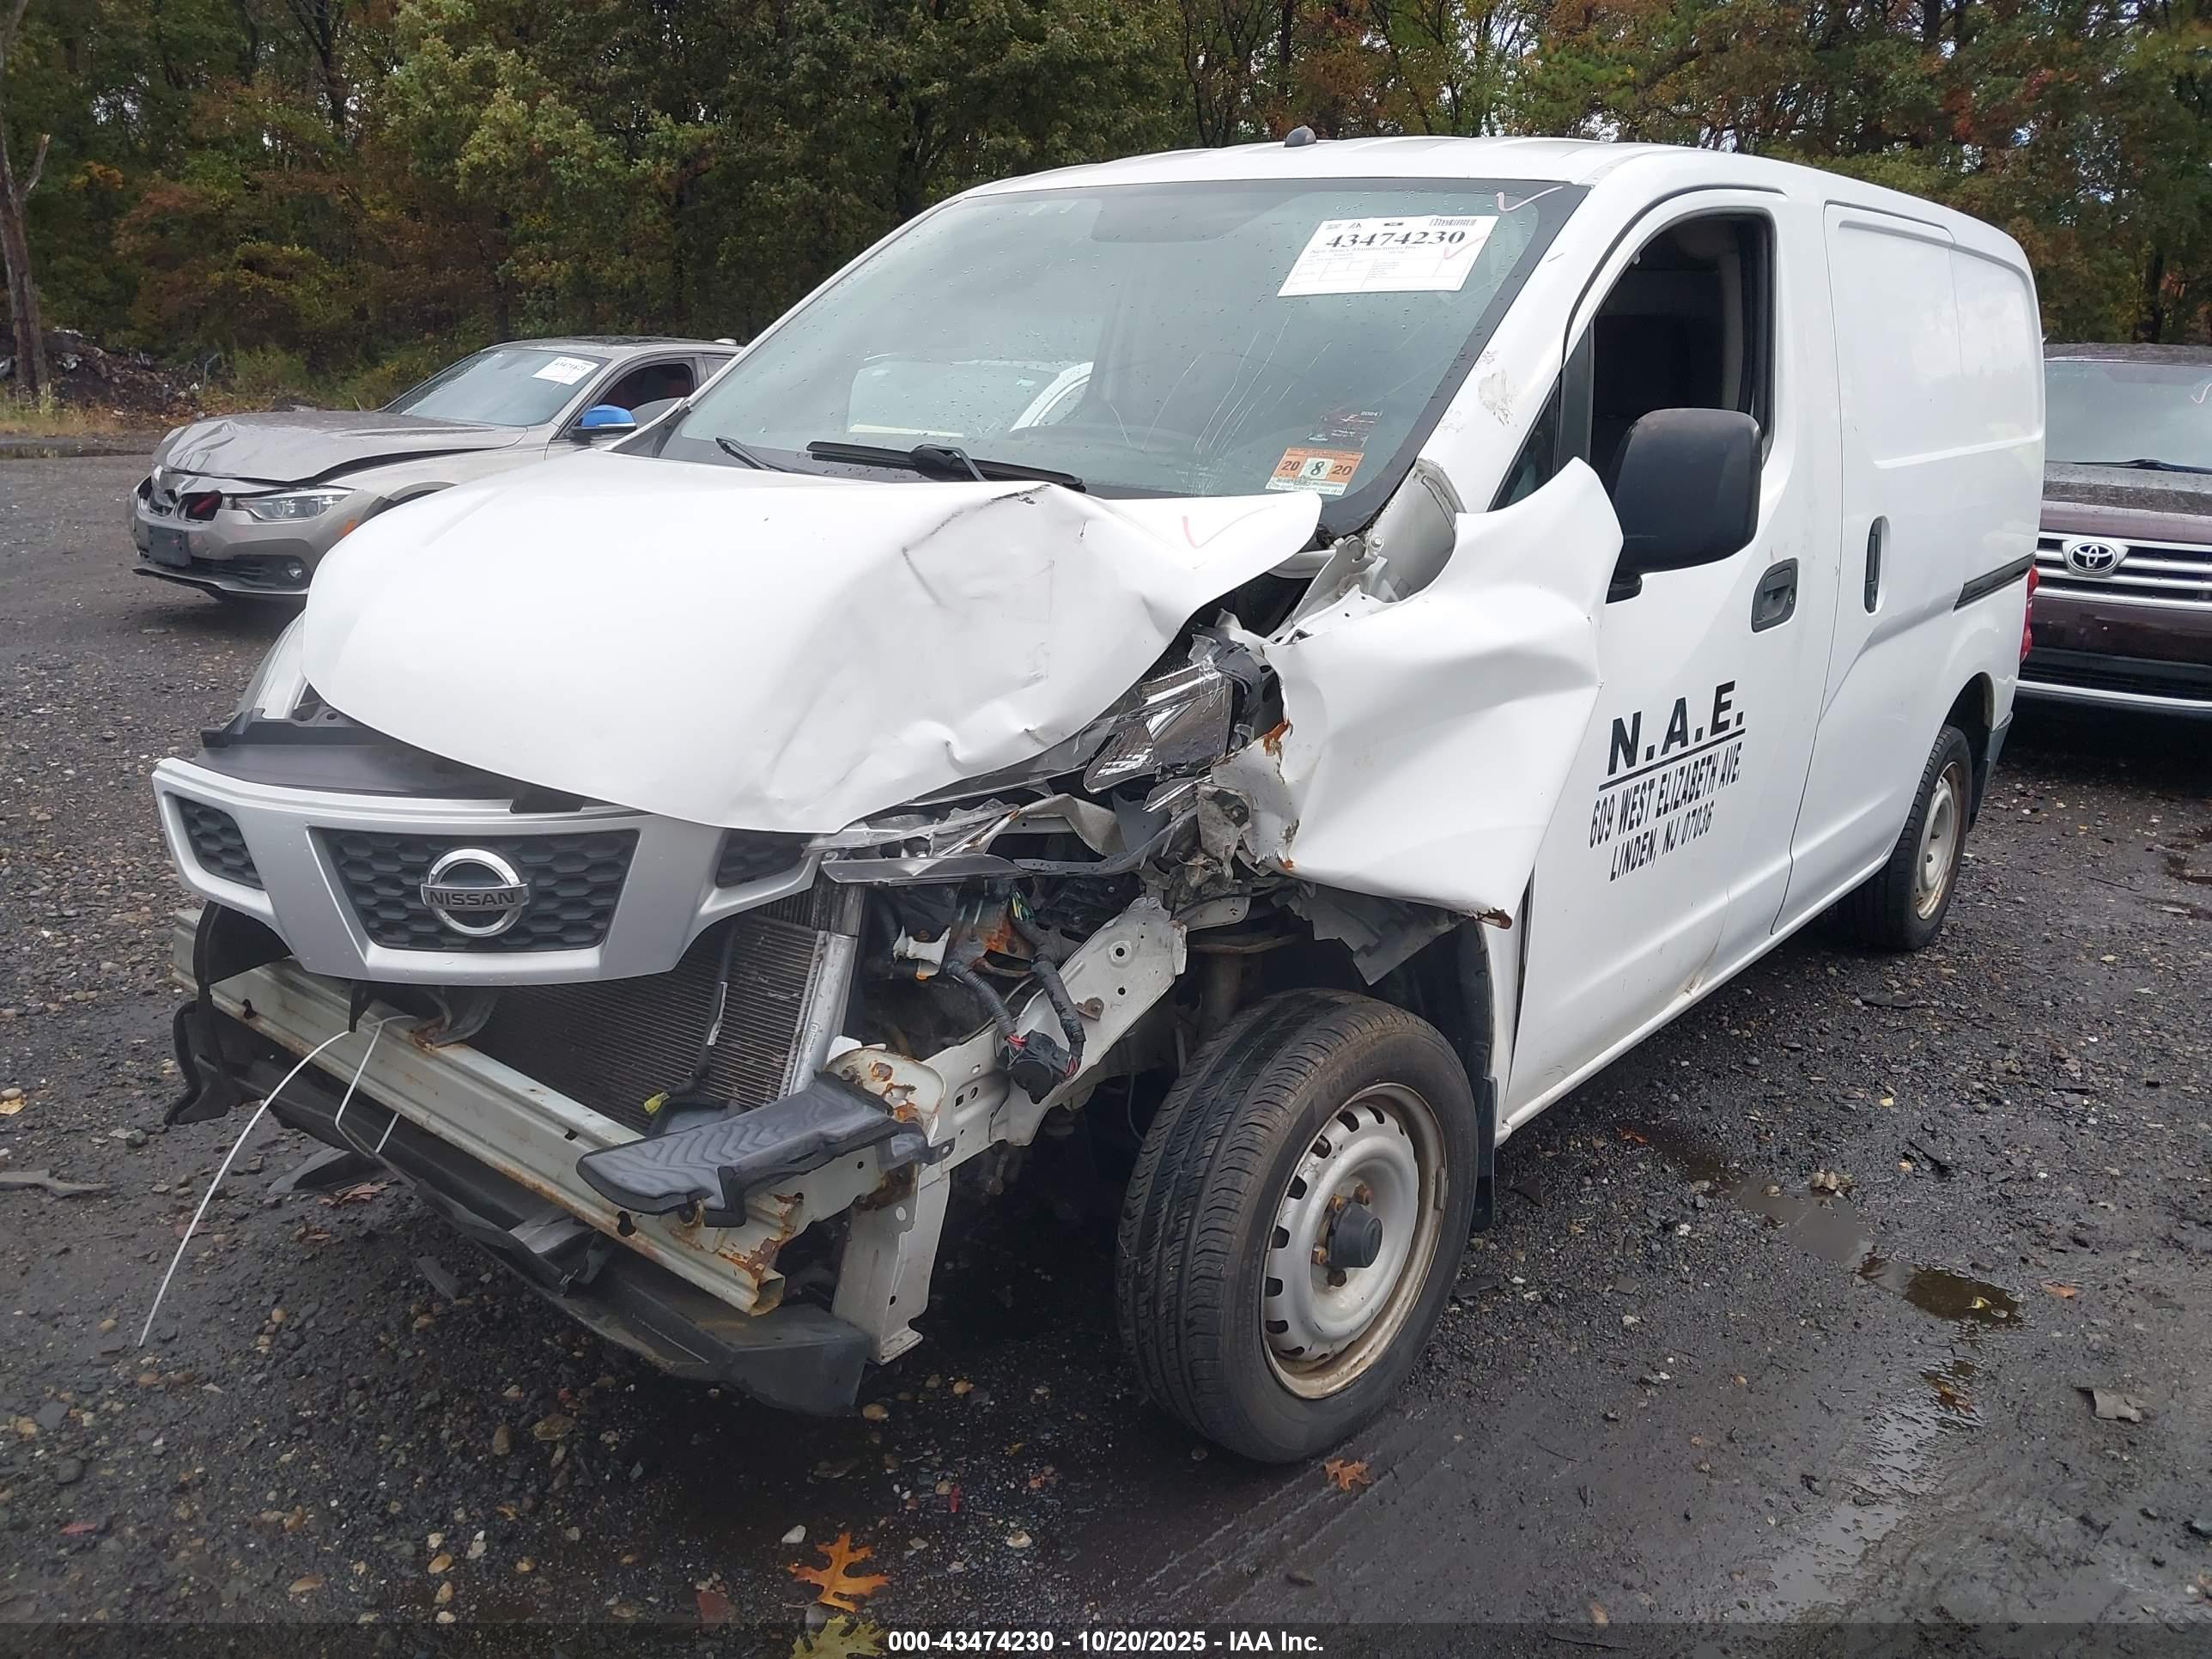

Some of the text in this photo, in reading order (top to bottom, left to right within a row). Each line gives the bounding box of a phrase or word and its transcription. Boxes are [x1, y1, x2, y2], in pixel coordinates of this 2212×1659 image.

[1325, 230, 1466, 247] 43474230
[1281, 460, 1352, 476] 20 8 20
[1607, 680, 1744, 776] N.A.E.
[1589, 793, 1615, 848] 609
[1618, 777, 1656, 836] WEST
[1655, 750, 1719, 819] ELIZABETH
[1609, 799, 1715, 882] LINDEN, NJ 07036
[430, 890, 515, 905] NISSAN
